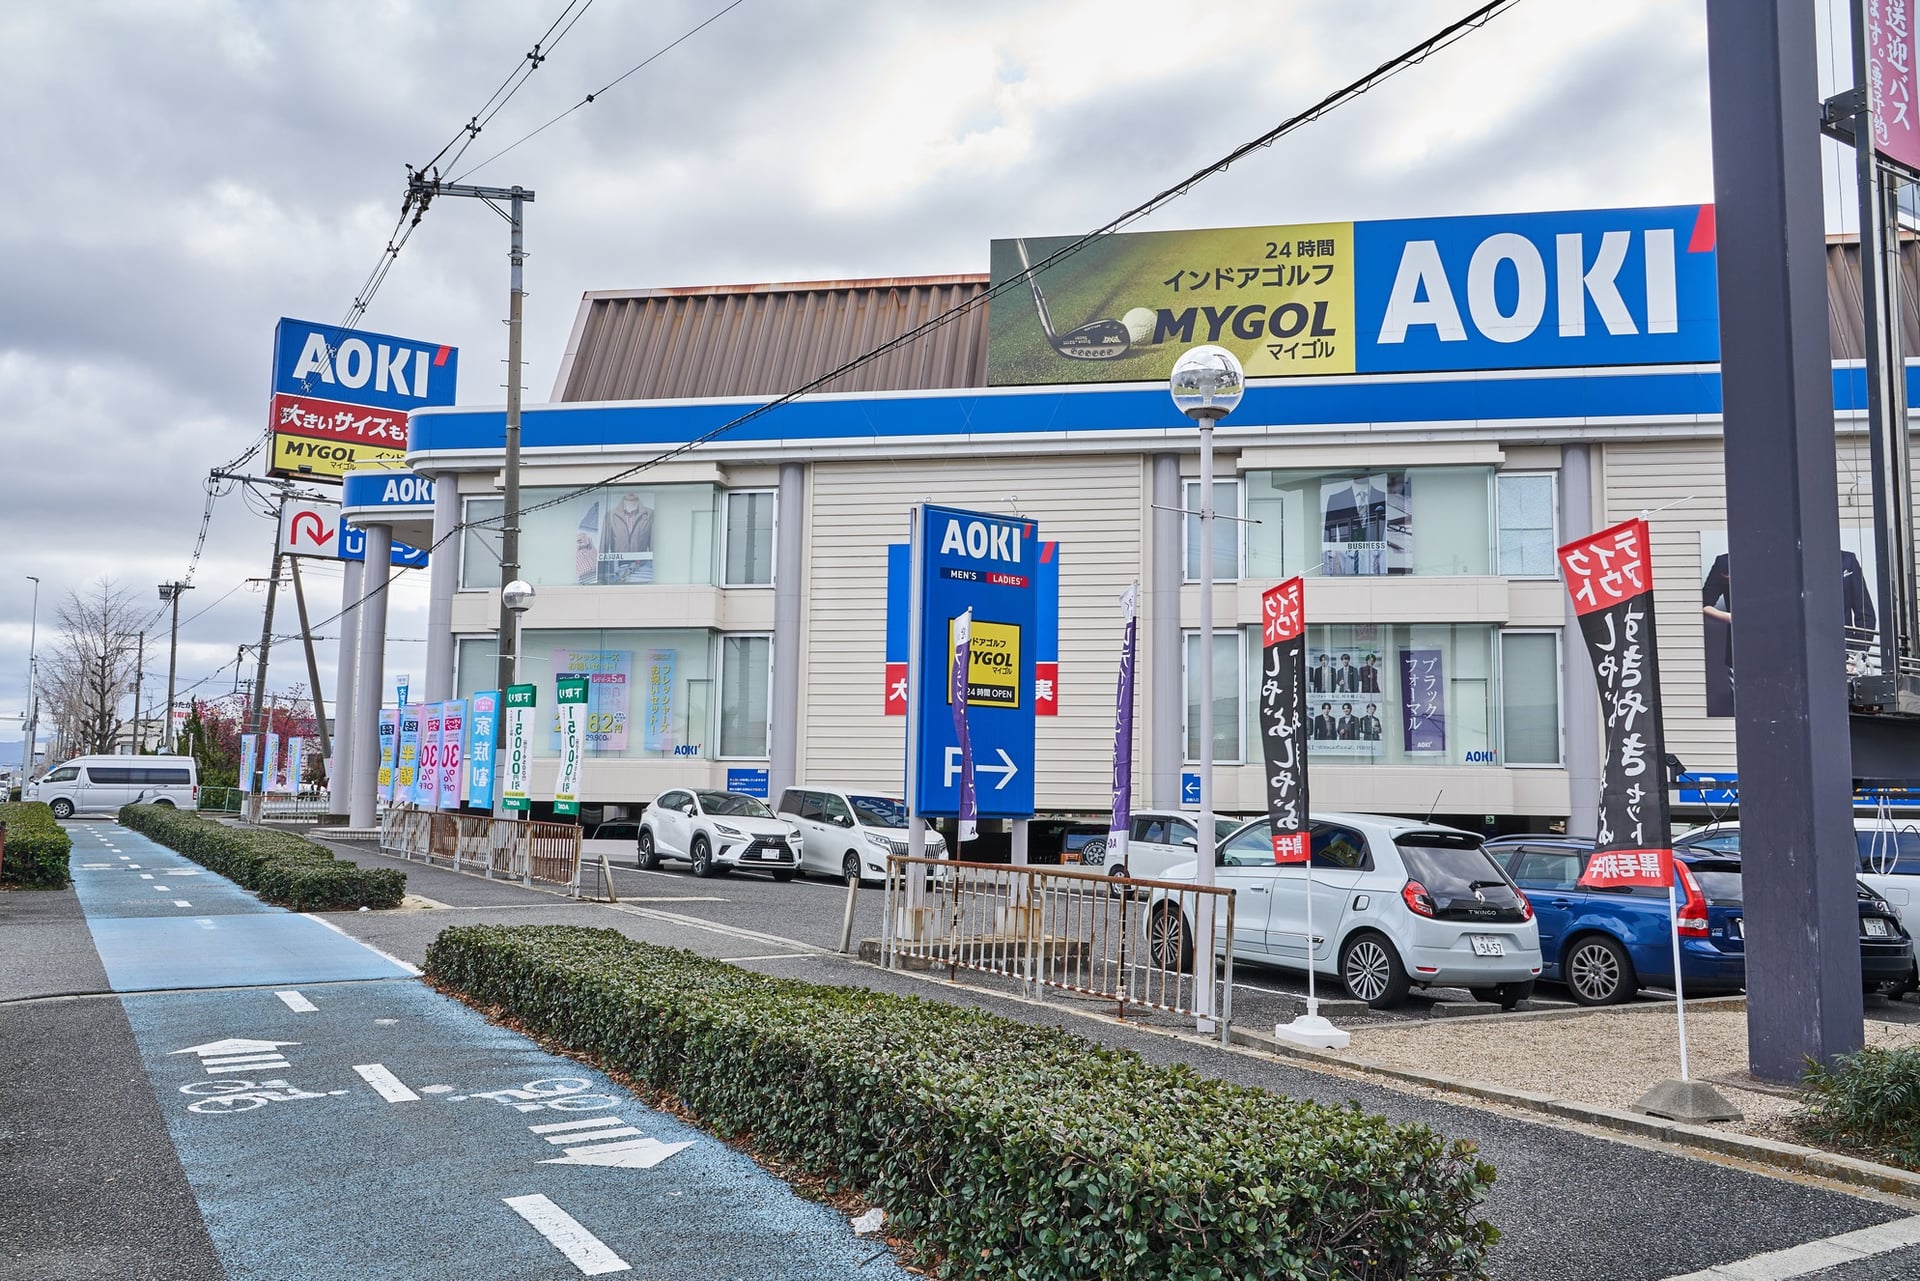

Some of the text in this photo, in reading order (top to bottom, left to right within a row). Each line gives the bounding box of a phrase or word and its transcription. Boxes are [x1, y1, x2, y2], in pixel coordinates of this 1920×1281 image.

[1163, 260, 1335, 294] インドアゴルフ
[1376, 229, 1679, 345] AOKI
[1152, 300, 1337, 345] MYGOL
[1266, 338, 1336, 361] マイゴル
[292, 332, 430, 398] AOKI
[280, 403, 408, 442] 大きいサイズも
[285, 441, 357, 463] MYGOL
[329, 461, 357, 471] マイゴル
[940, 519, 1022, 563] AOKI
[1347, 542, 1386, 550] BUSINESS
[598, 553, 624, 561] CASUAL
[950, 569, 977, 581] MEN'S
[968, 637, 1007, 648] ドアゴルフ
[661, 664, 672, 734] フレッシャーズ
[992, 688, 1013, 699] OPEN
[1405, 659, 1422, 731] フォーマル
[1422, 657, 1438, 720] ブラック
[673, 745, 698, 755] AOKI
[1465, 751, 1494, 762] AOKI
